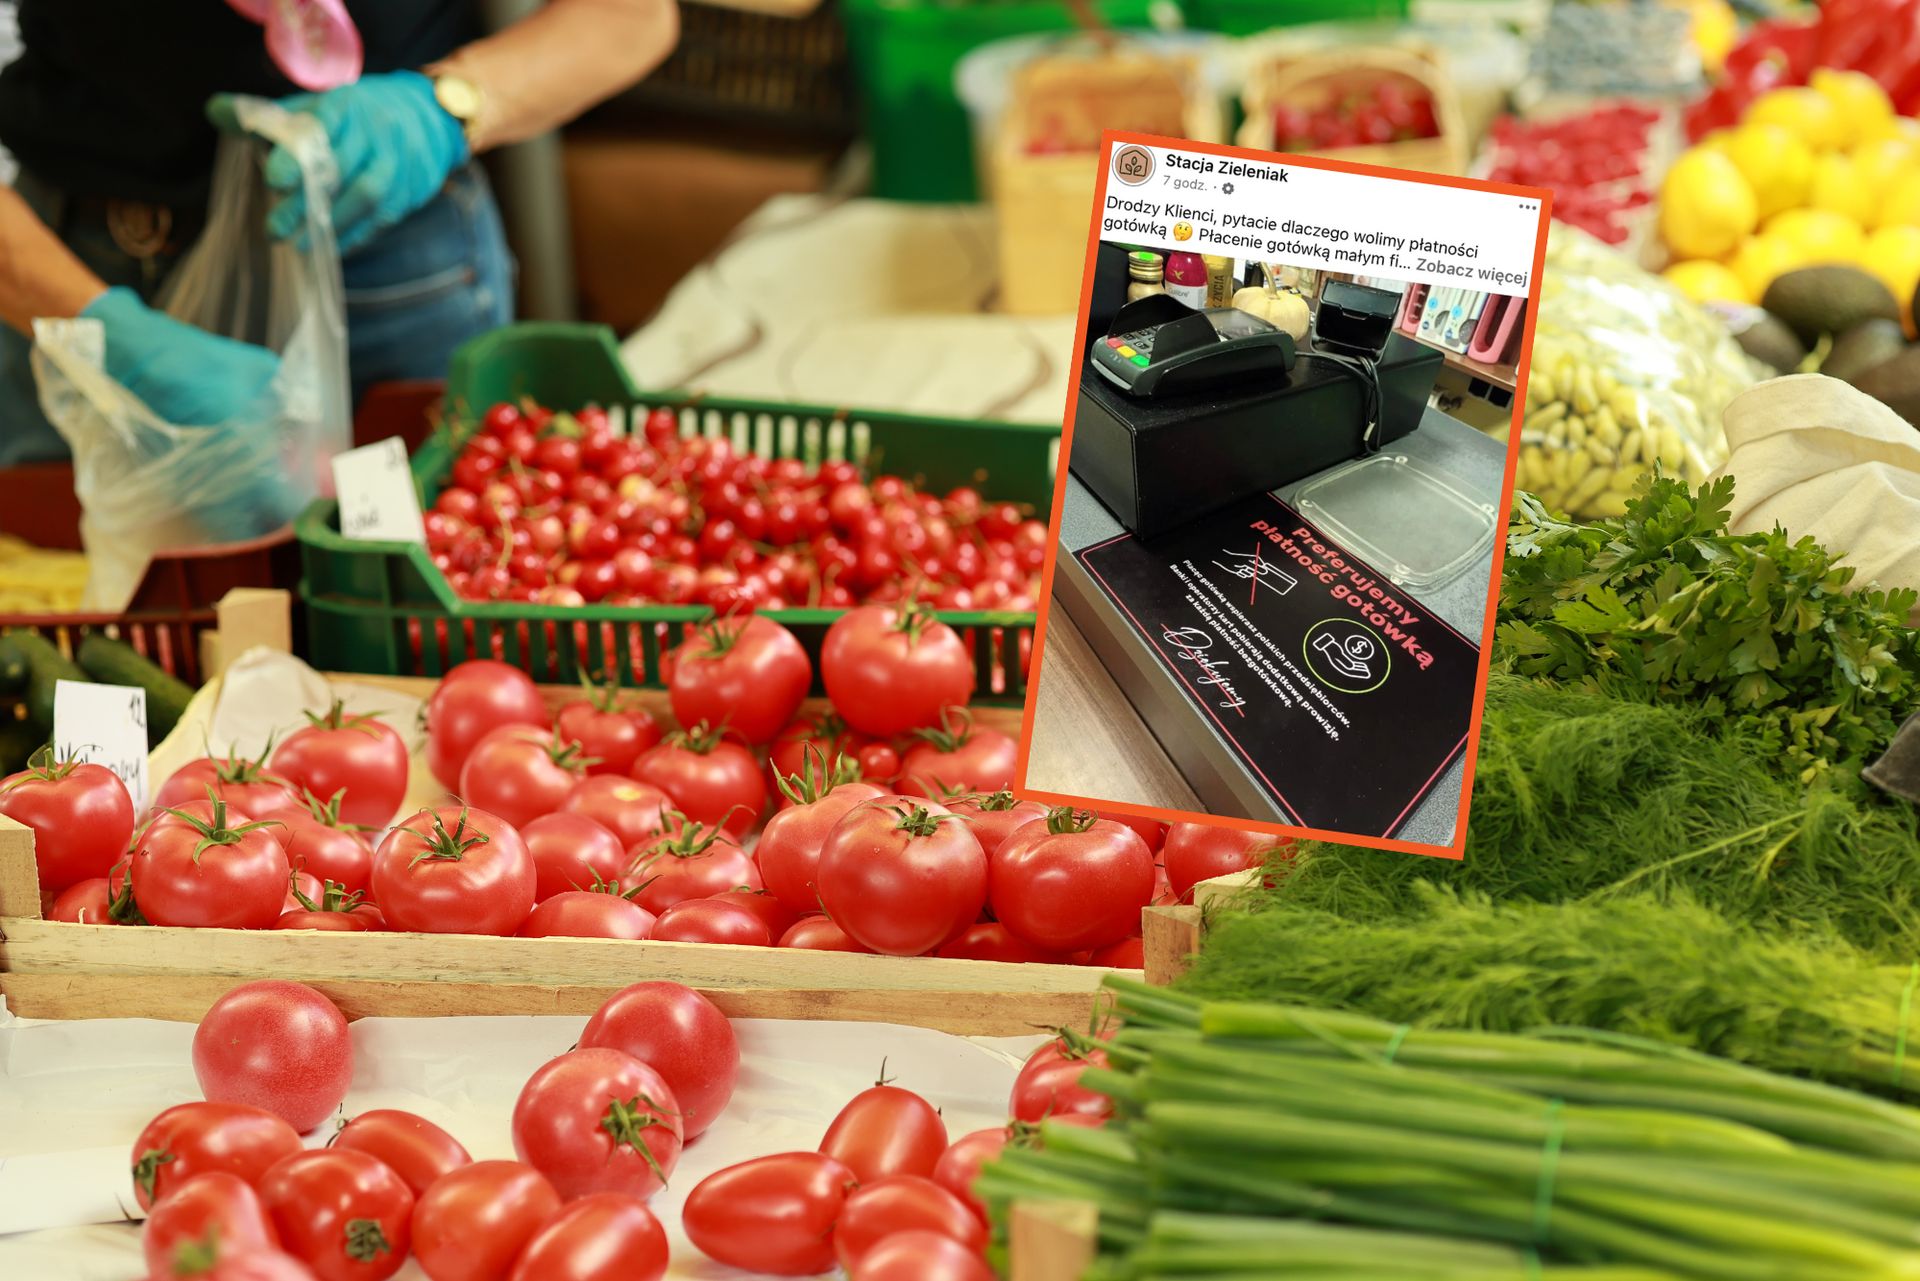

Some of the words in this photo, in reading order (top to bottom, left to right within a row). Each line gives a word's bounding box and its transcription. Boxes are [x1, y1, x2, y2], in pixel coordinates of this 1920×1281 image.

[1169, 563, 1188, 582] Banki
[1187, 582, 1221, 615] operatorzy
[1218, 612, 1235, 629] kart
[1230, 627, 1263, 661] pobierają
[1262, 659, 1304, 703] dodatkową
[1250, 520, 1339, 584] płatność
[1330, 584, 1434, 671] gotówką
[1291, 527, 1420, 626] Preferujemy
[1185, 594, 1195, 603] za
[1209, 619, 1242, 650] płatność
[1237, 648, 1292, 708] bezgotówkową.
[1200, 577, 1227, 603] gotówką
[1225, 601, 1258, 633] wspierasz
[1255, 632, 1286, 662] polskich
[1283, 660, 1351, 728] przedsiębiorców.
